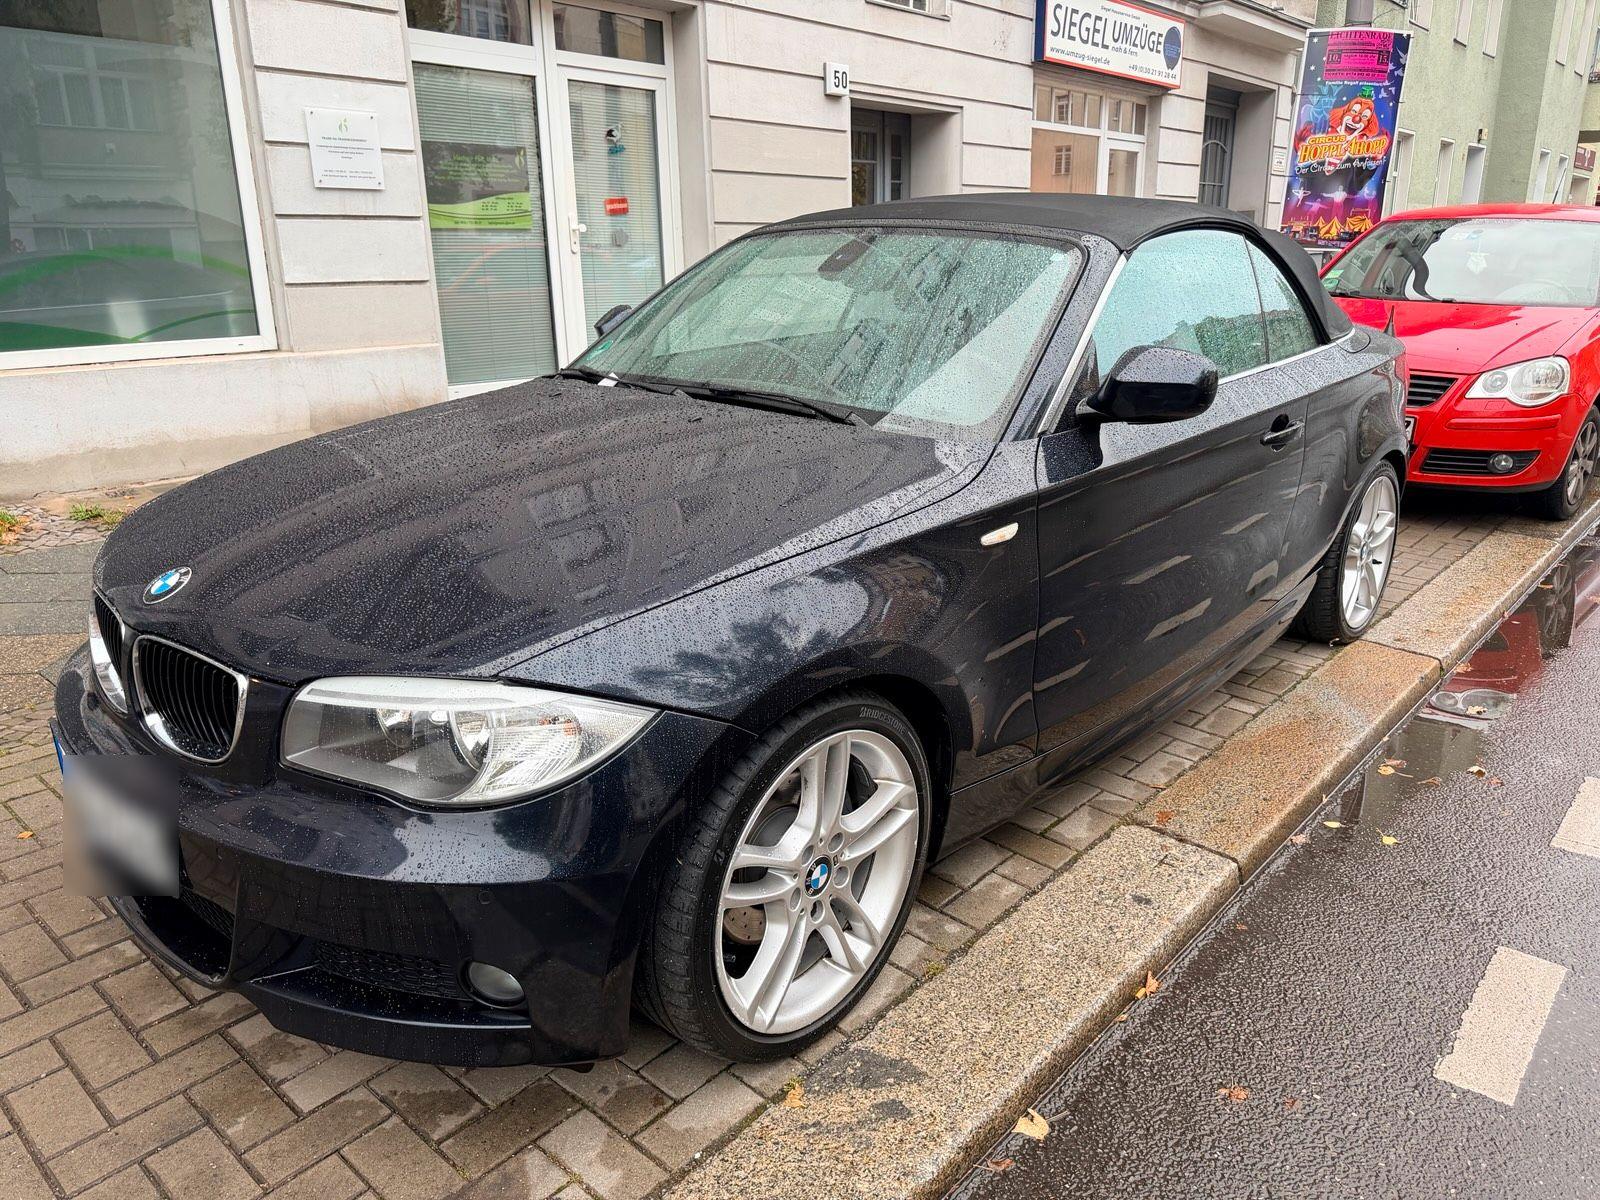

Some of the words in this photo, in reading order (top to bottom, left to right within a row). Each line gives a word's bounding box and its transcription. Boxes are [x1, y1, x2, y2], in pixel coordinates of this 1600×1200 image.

[1050, 3, 1109, 50] SIEGEL
[1112, 20, 1163, 54] UMZÜGE
[1050, 46, 1110, 65] www.umzug-siegel.de
[834, 70, 847, 89] 50
[1308, 135, 1346, 145] CIRCUS
[1295, 165, 1308, 174] Der
